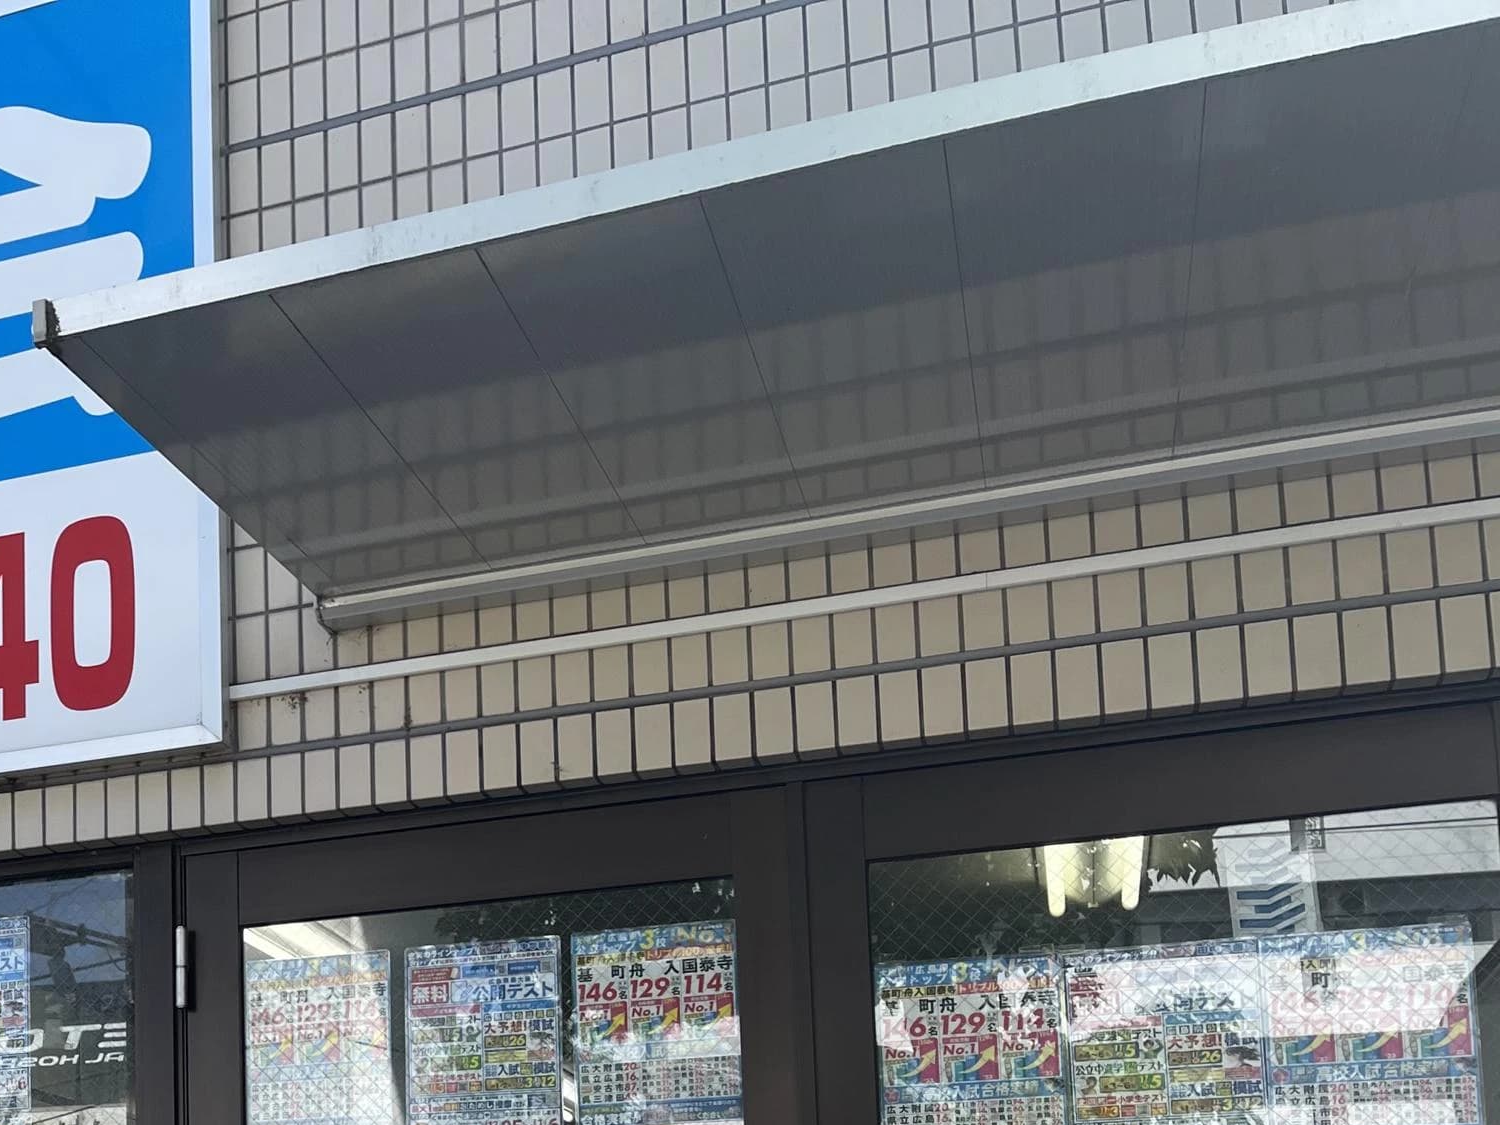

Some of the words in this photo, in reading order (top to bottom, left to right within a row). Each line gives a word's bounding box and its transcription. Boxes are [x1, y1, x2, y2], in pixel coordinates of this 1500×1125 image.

[629, 960, 680, 978] 舟入
[682, 955, 733, 974] 国泰寺
[412, 985, 449, 1004] 無料
[473, 981, 553, 1001] 公開テスト
[578, 982, 618, 1003] 146
[630, 977, 671, 999] 129
[684, 973, 723, 994] 114
[632, 1006, 661, 1018] No.1
[684, 1001, 714, 1013] No.1
[940, 994, 996, 1013] 舟入
[484, 1021, 527, 1034] 大予想!
[941, 1012, 986, 1035] 129
[509, 1035, 525, 1046] 26
[1168, 1034, 1222, 1049] 大予想!
[886, 1047, 917, 1060] No.1
[943, 1043, 976, 1056] No.1
[1201, 1050, 1221, 1062] 26
